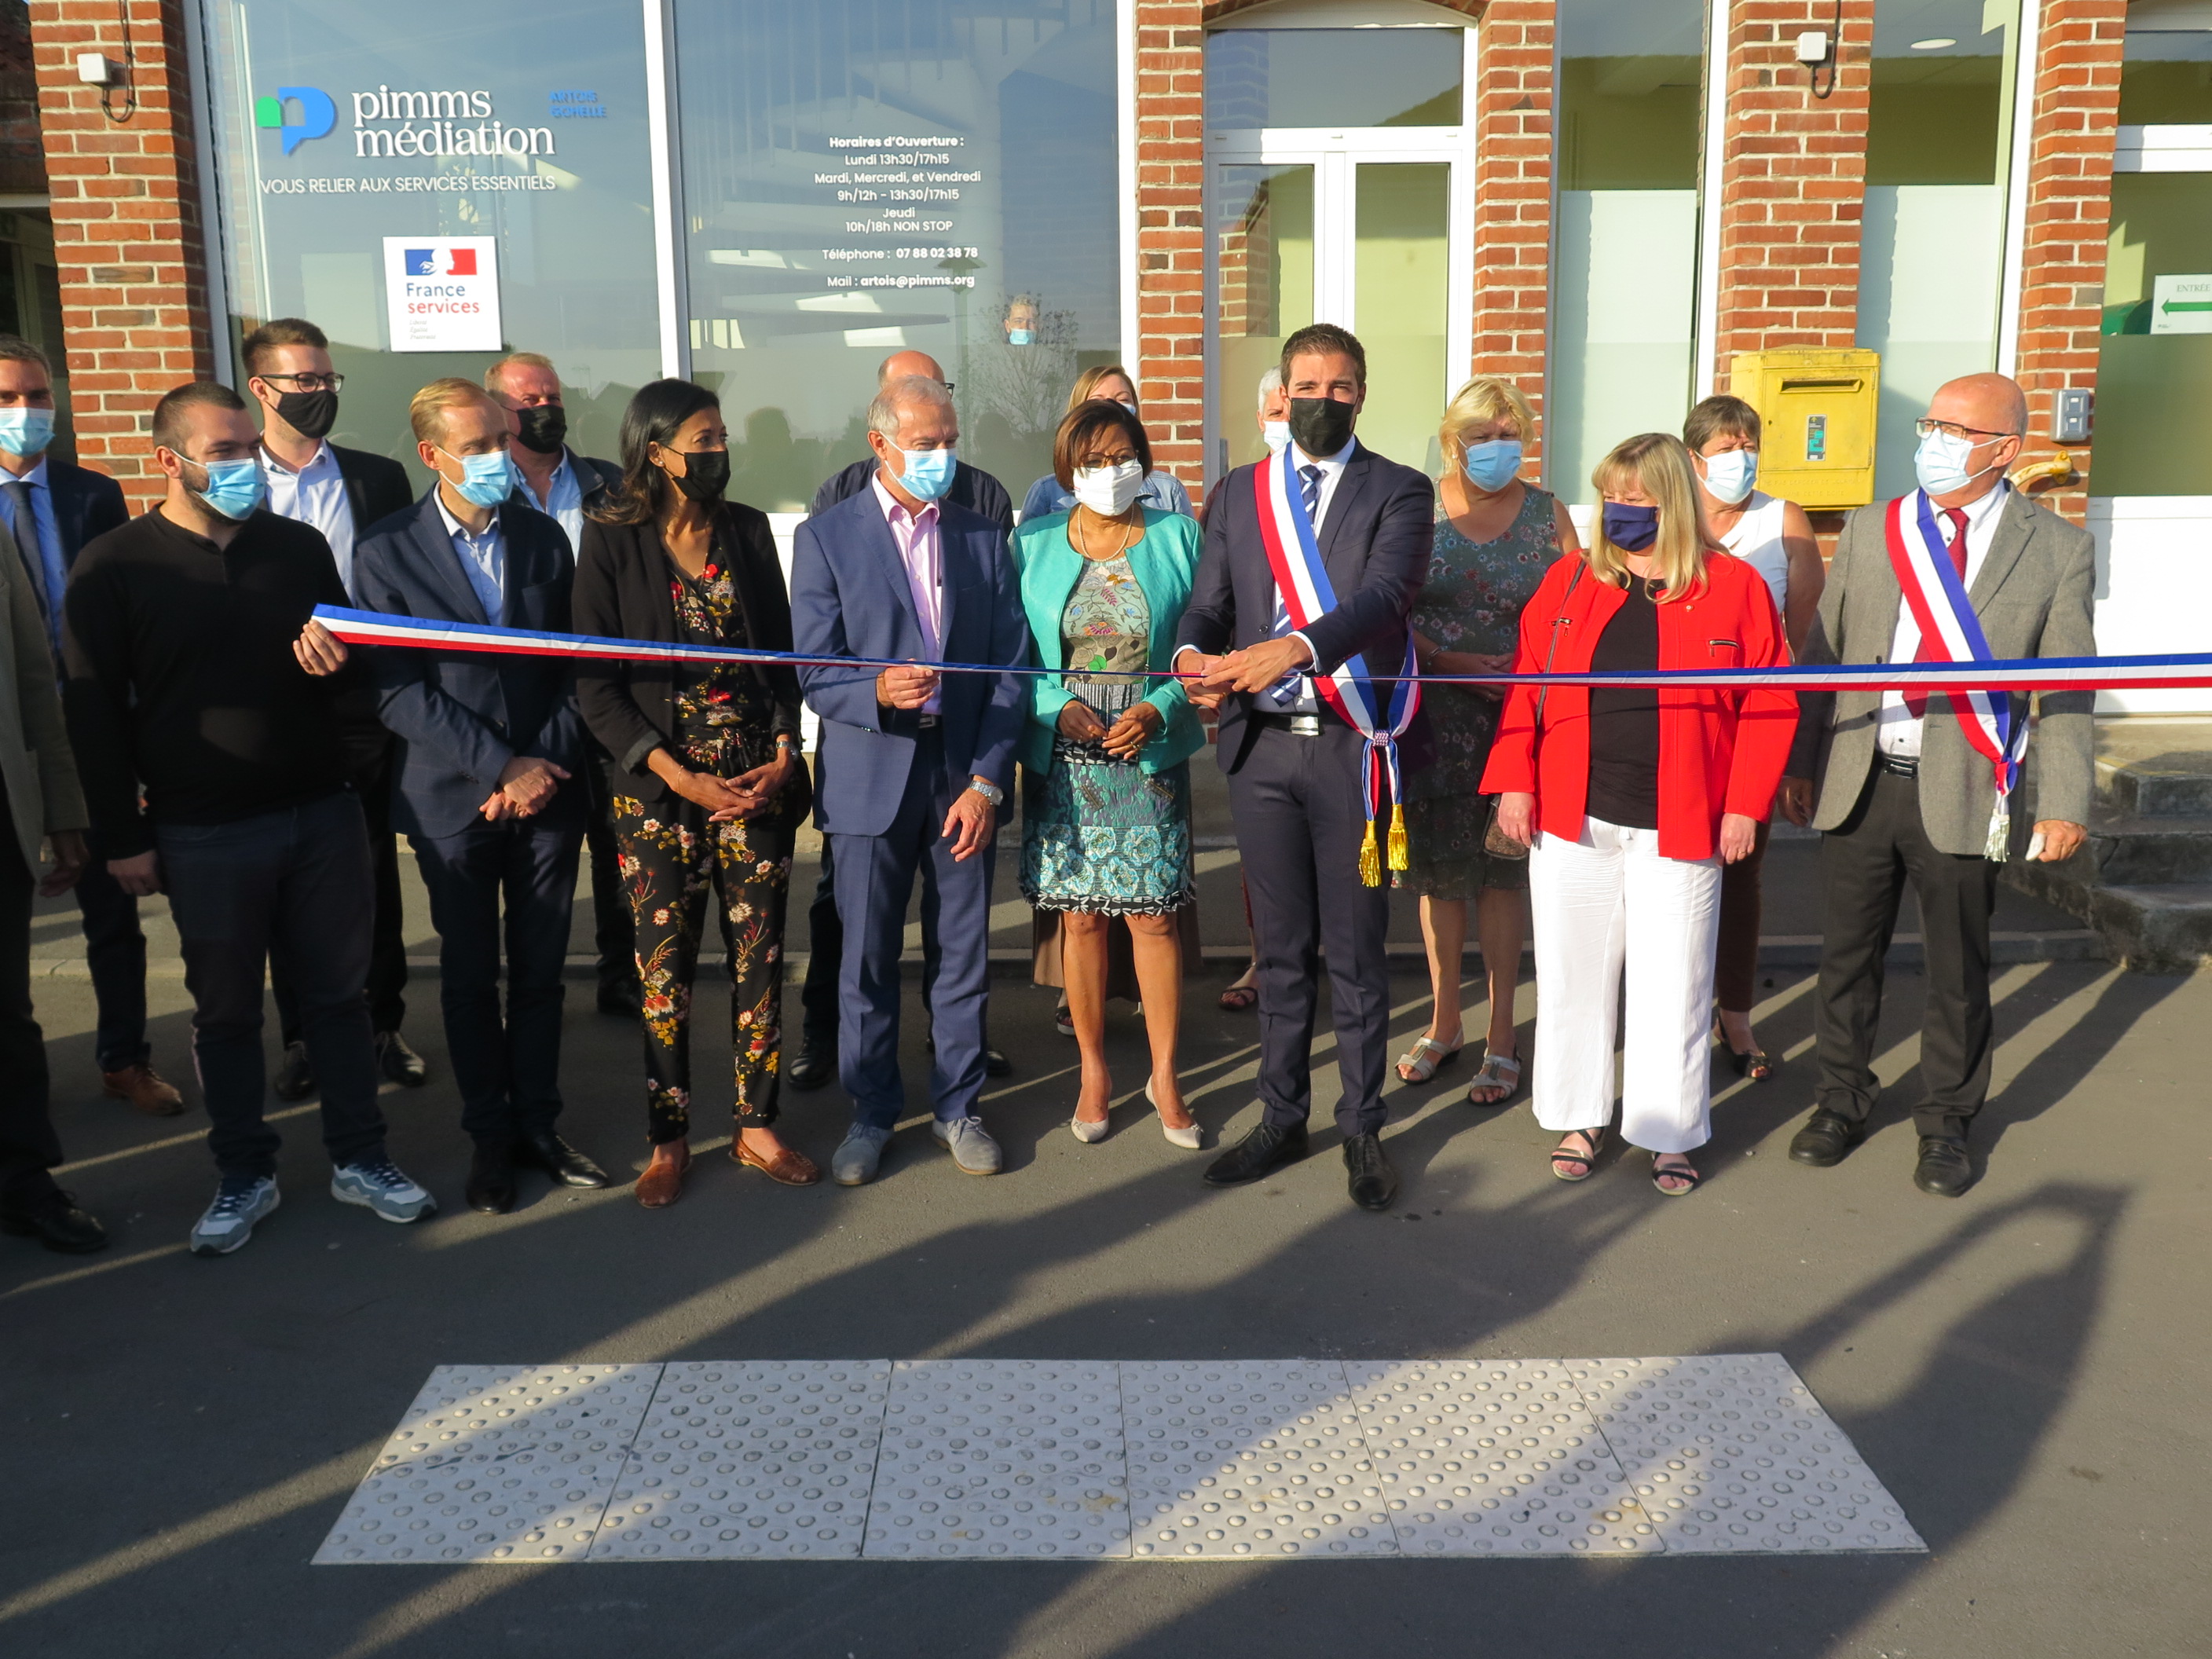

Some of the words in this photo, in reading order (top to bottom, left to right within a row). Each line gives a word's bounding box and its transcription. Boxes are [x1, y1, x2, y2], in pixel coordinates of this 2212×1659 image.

[351, 84, 493, 128] pimms
[353, 120, 555, 157] médiation
[830, 136, 881, 148] Horaires
[844, 155, 877, 166] Lundi
[879, 152, 950, 167] 13h30/17h15
[259, 178, 306, 194] VOUS
[309, 178, 356, 193] RELIER
[359, 178, 392, 192] AUX
[395, 176, 468, 192] SERVICES
[472, 175, 556, 191] ESSENTIELS
[815, 173, 851, 185] Mardi,
[854, 171, 910, 184] Mercredi,
[912, 173, 925, 183] et
[926, 170, 981, 182] Vendredi
[837, 188, 877, 203] 9h/12h
[889, 187, 959, 202] 13h30/17h15
[882, 207, 915, 218] Jeudi
[845, 219, 890, 234] 10h/18h
[894, 222, 920, 232] NON
[922, 221, 953, 231] STOP
[822, 248, 884, 262] Téléphone
[895, 247, 911, 258] 07
[912, 247, 928, 258] 88
[930, 247, 946, 258] 02
[947, 247, 962, 258] 38
[963, 247, 978, 258] 78
[827, 276, 851, 287] Mail
[860, 274, 975, 289] artois@pimms.org
[406, 283, 466, 297] France
[408, 298, 480, 313] services
